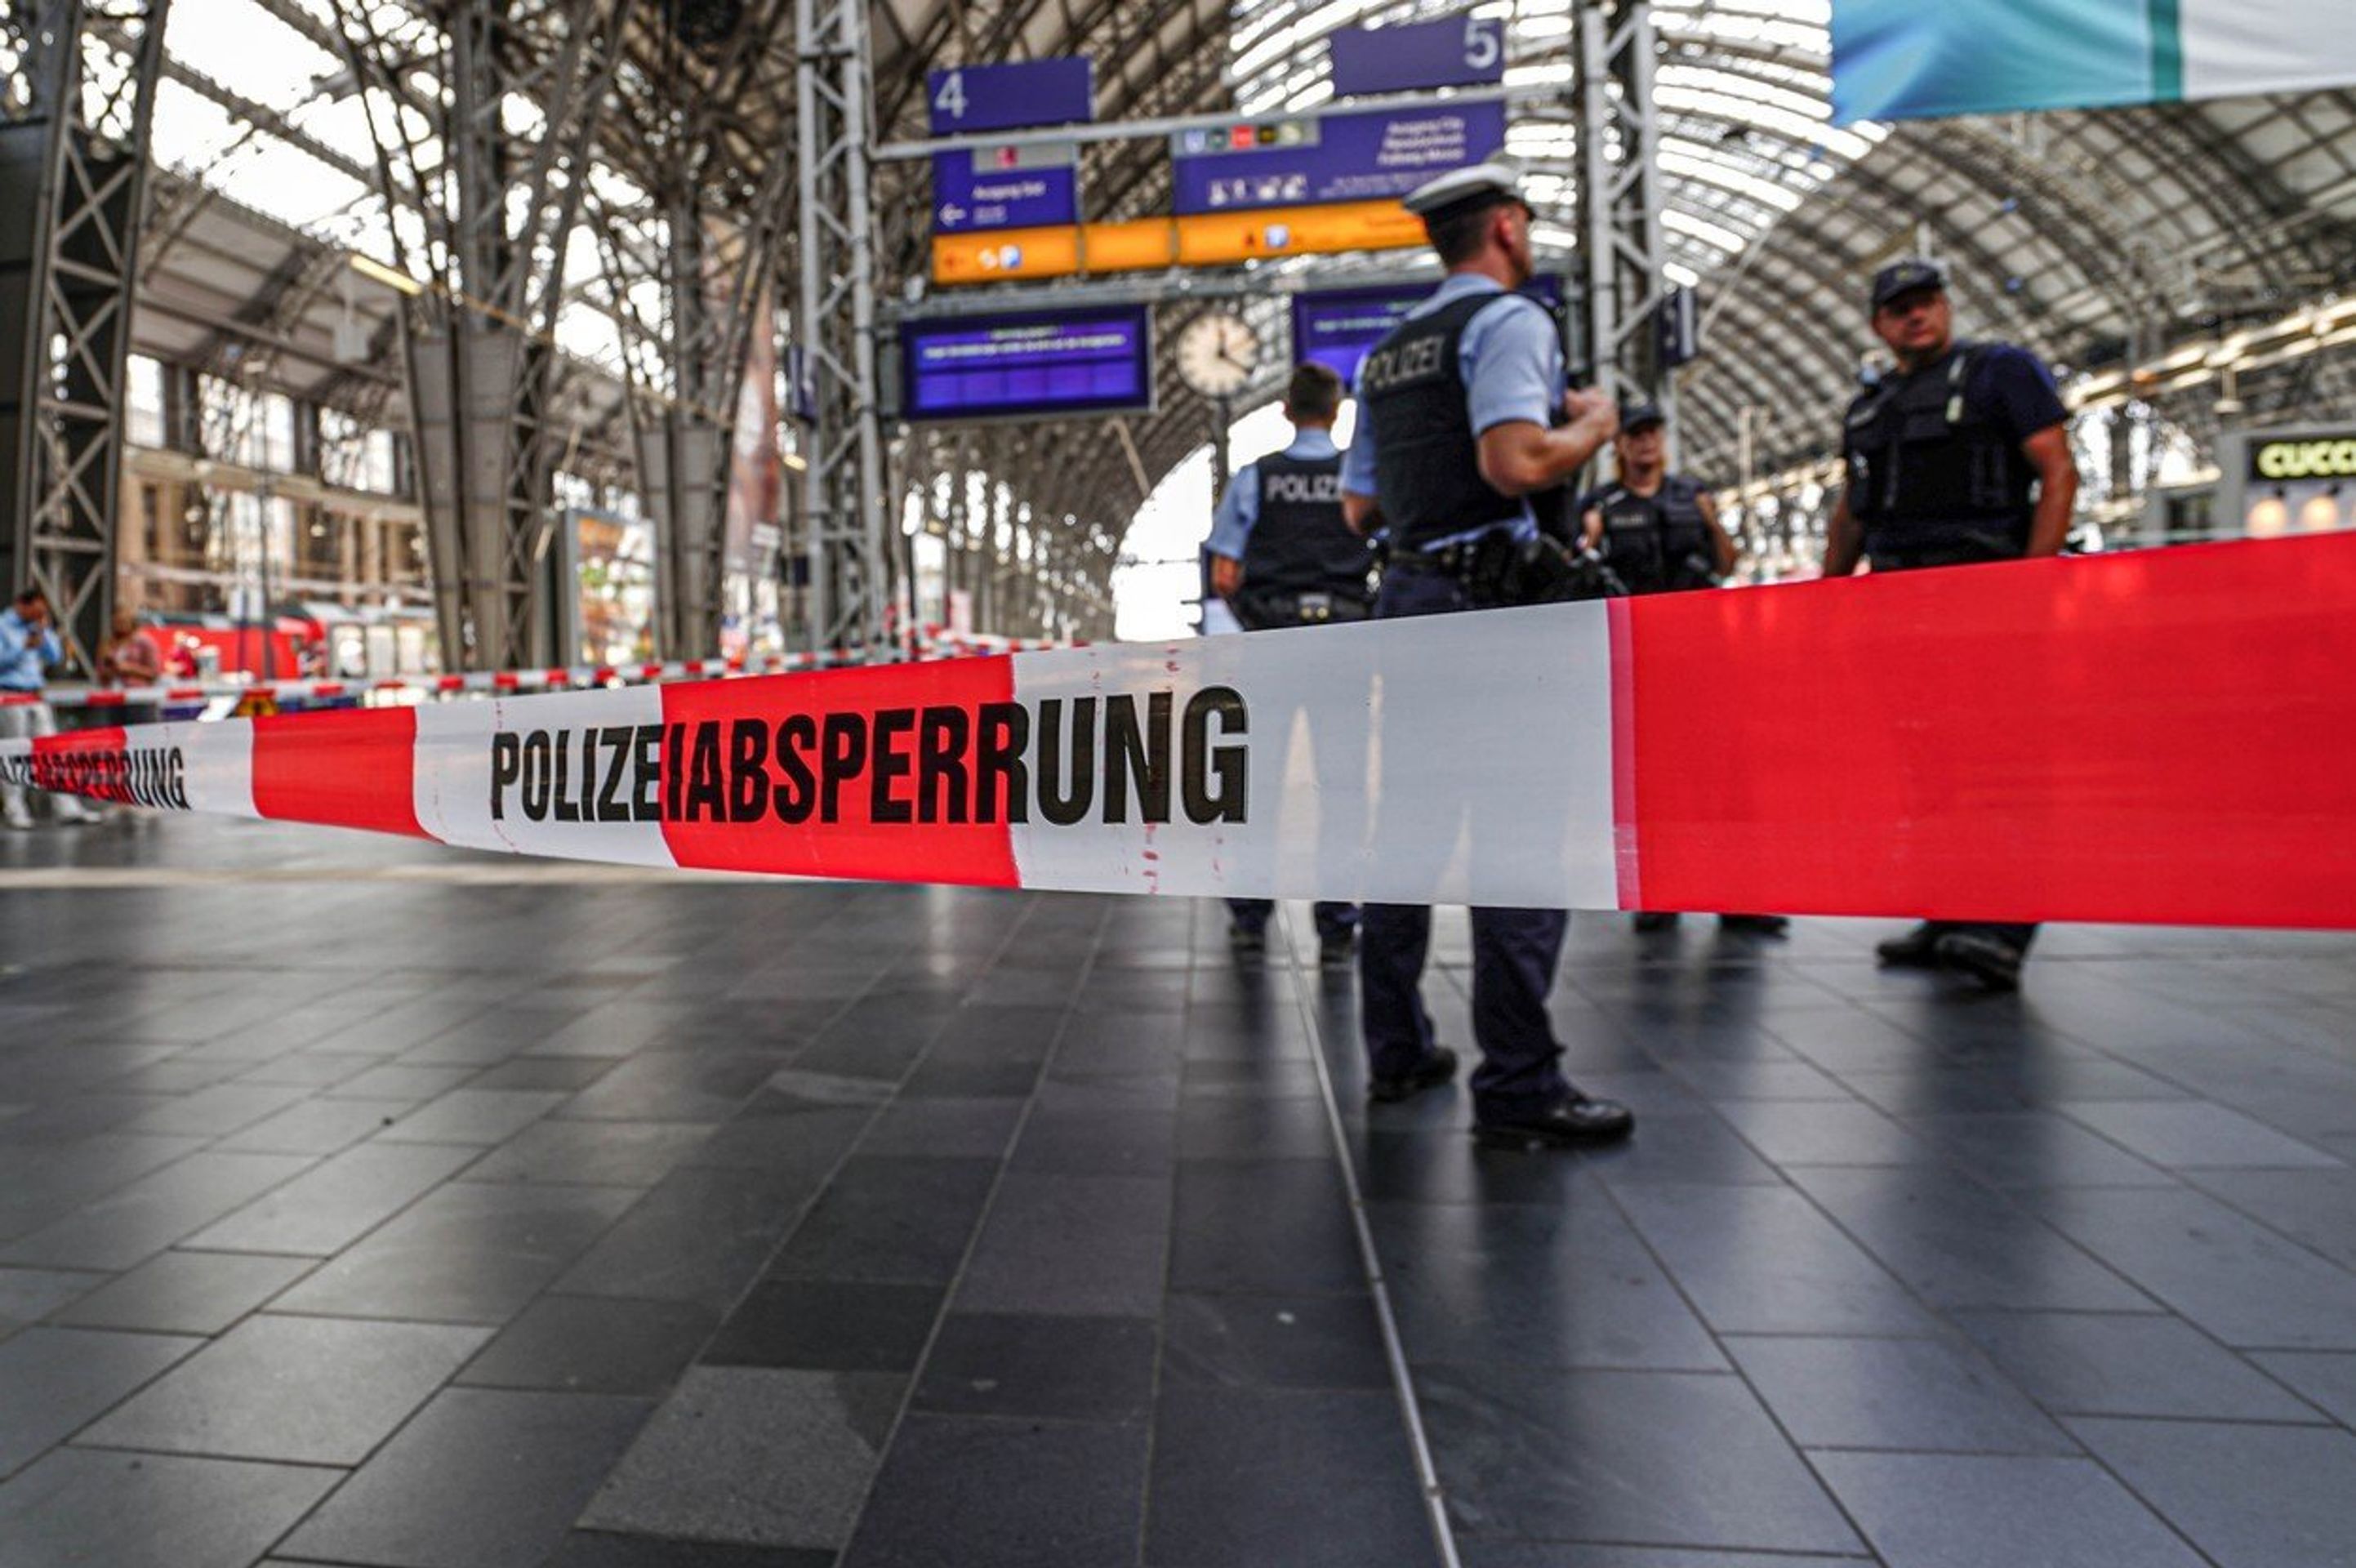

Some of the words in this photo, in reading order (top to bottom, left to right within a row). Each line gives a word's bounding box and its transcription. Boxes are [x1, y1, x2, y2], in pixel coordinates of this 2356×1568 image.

[1464, 20, 1498, 68] 5
[935, 72, 968, 118] 4
[1365, 335, 1446, 390] POLIZEI
[492, 685, 1250, 825] POLIZEIABSPERRUNG
